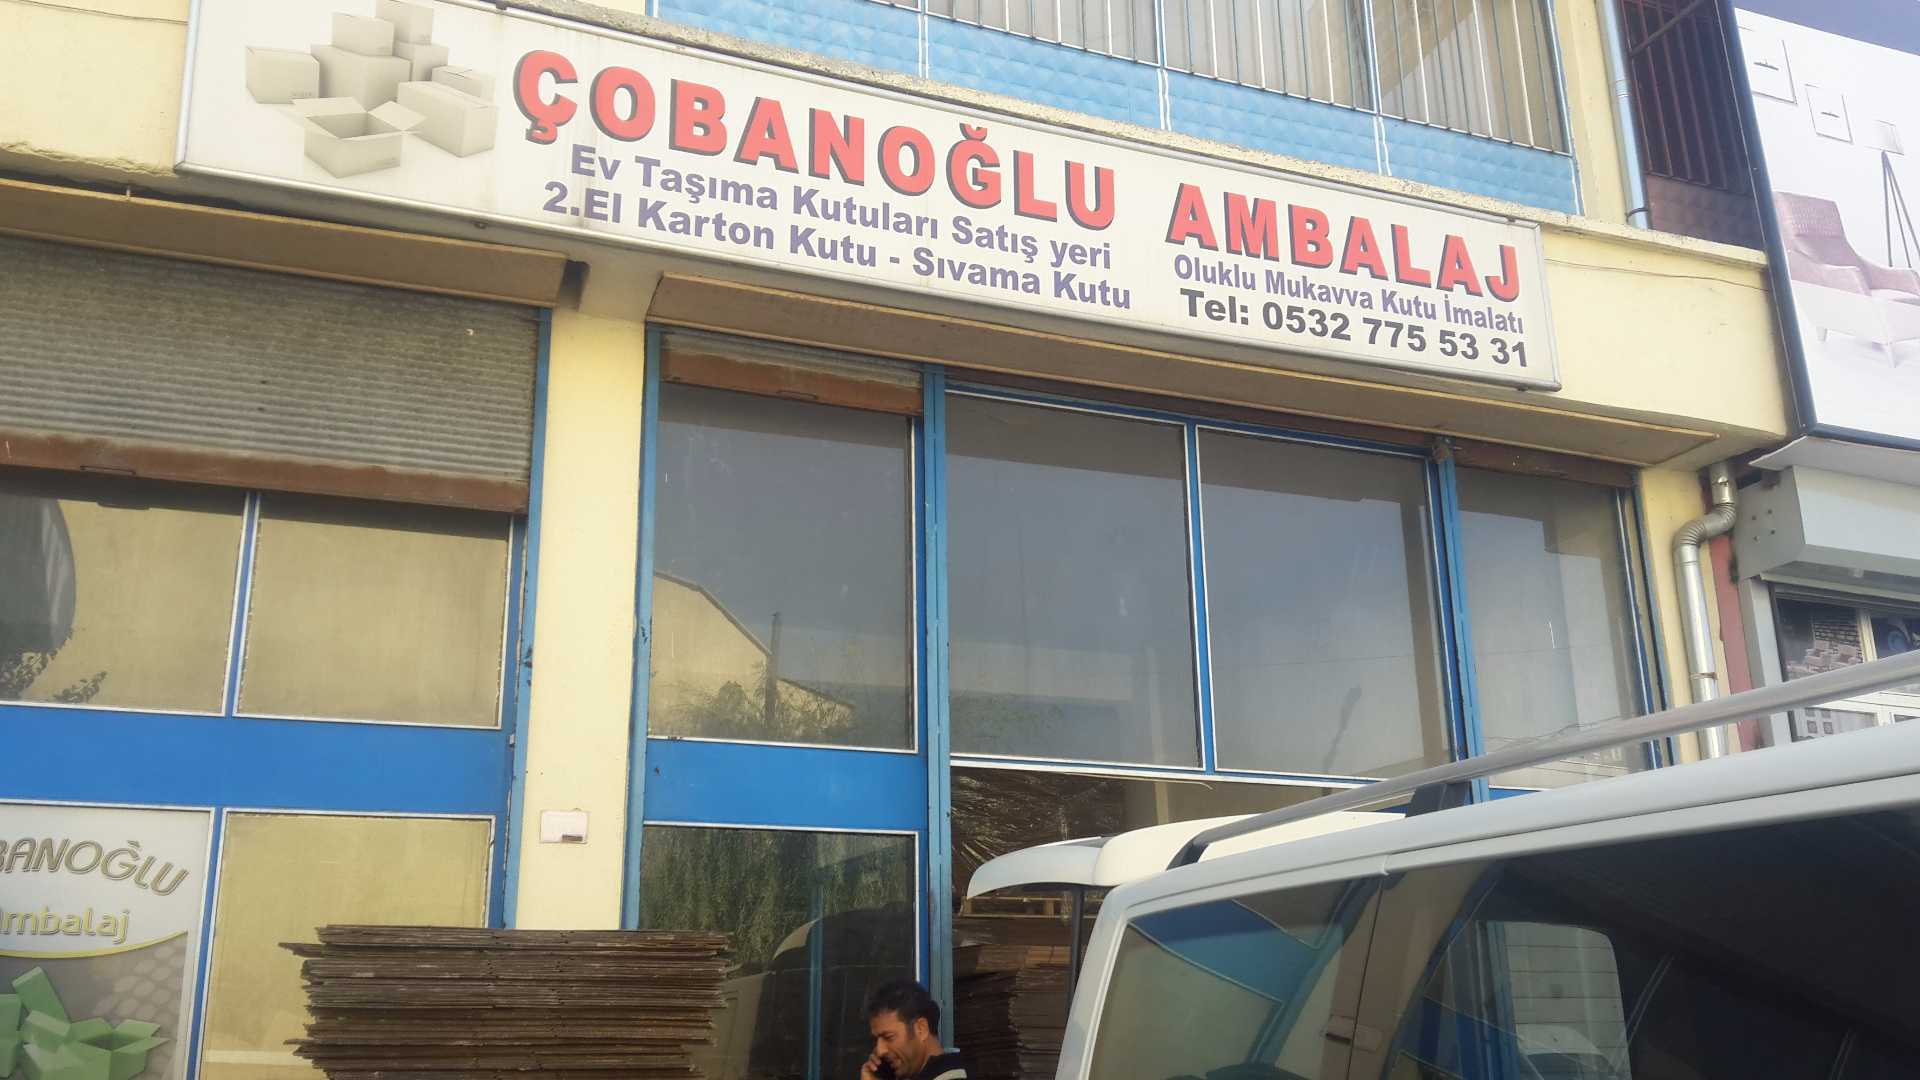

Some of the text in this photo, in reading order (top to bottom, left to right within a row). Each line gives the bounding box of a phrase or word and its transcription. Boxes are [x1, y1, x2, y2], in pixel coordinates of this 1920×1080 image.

[513, 49, 1521, 302] ÇOBANOĞLU AMBALAJ
[571, 143, 1111, 270] Ev Taşıma Kutuları Satış yeri
[543, 181, 1131, 309] 2.El Karton Kutu - Sıvama Kutu
[1174, 254, 1524, 334] Oluklu Mukavva Kutu İmalatı
[1180, 288, 1528, 367] Tel: 0532 775 53 31
[0, 906, 130, 944] mbalaj
